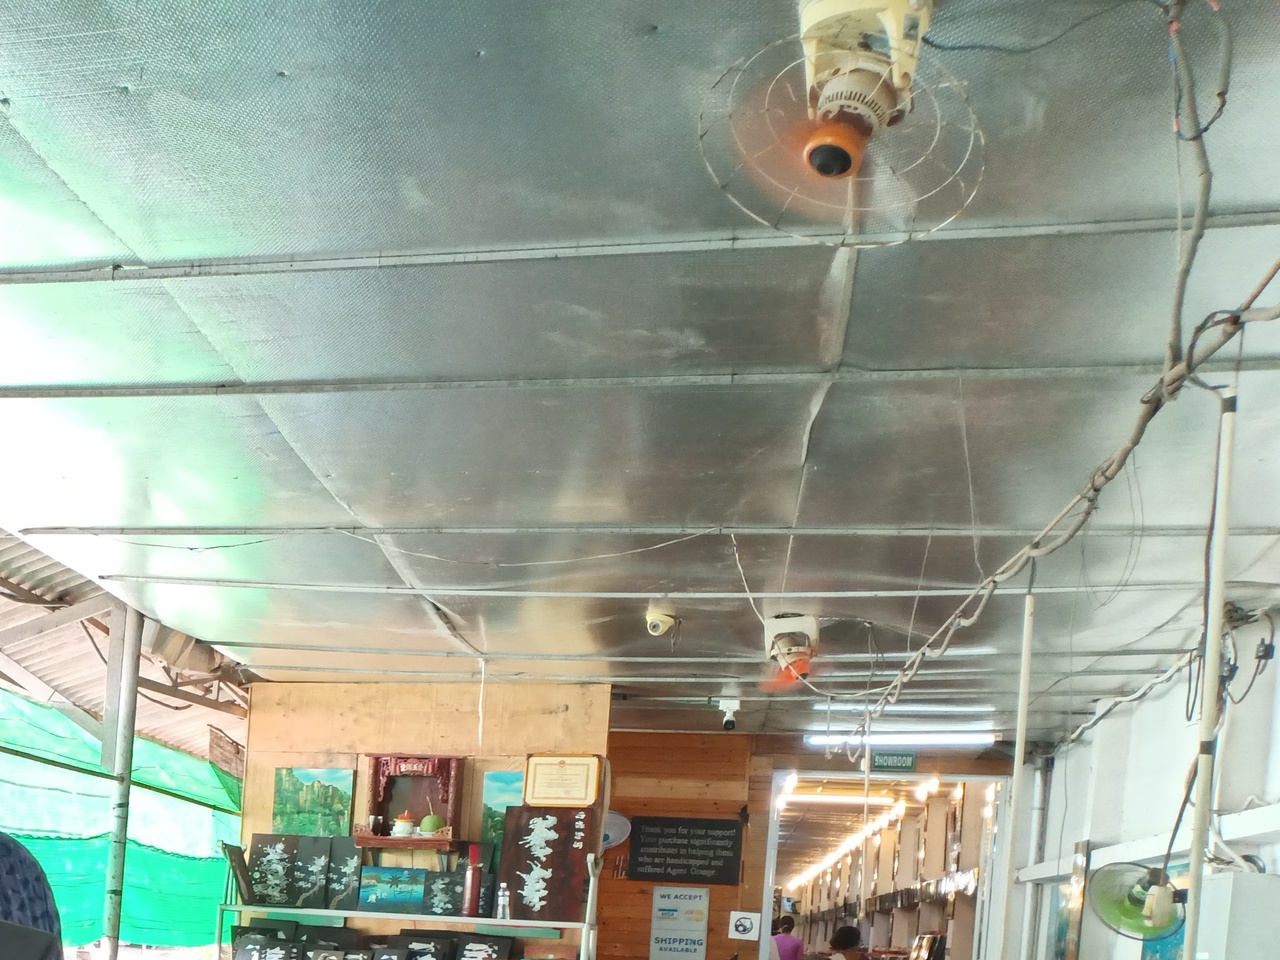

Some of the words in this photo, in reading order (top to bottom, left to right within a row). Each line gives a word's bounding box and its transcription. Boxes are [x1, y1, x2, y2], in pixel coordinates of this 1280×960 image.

[875, 756, 912, 766] SHOWROOM
[642, 825, 661, 833] Thank
[678, 826, 688, 834] for
[707, 829, 736, 837] support!
[640, 835, 657, 843] Your
[658, 837, 688, 845] purchase
[690, 838, 733, 847] significantly
[640, 846, 677, 854] contributes
[688, 847, 714, 857] helping
[666, 857, 709, 866] handicapped
[637, 865, 664, 873] suffered
[666, 867, 687, 875] Agent
[690, 868, 718, 877] Orange.
[654, 937, 703, 946] SHIPPING
